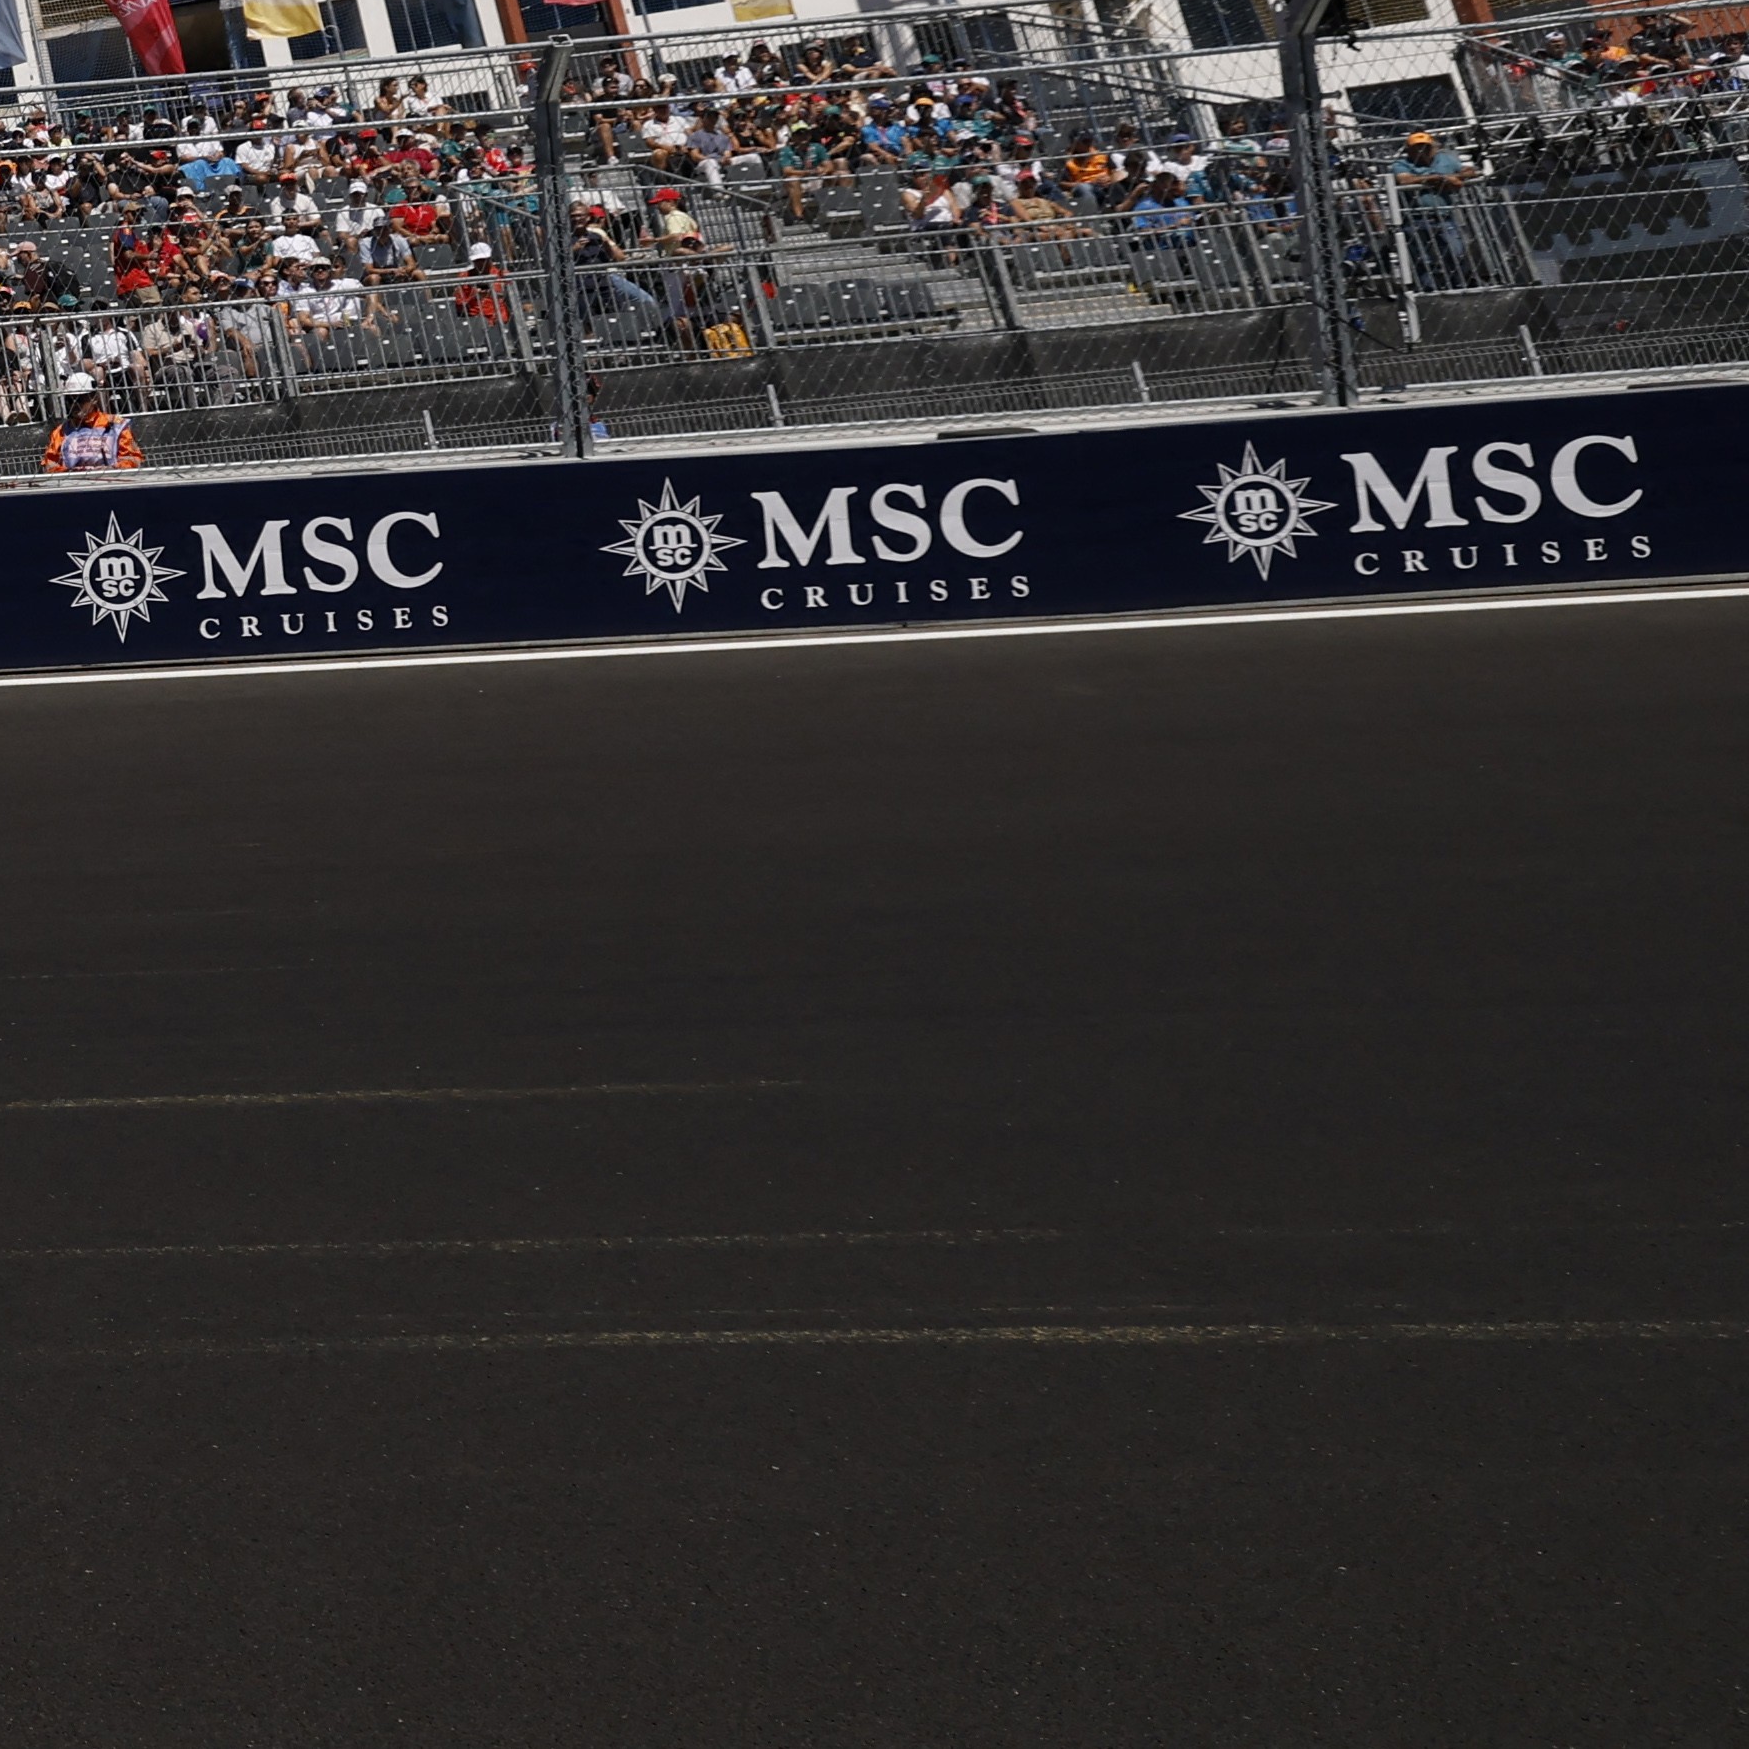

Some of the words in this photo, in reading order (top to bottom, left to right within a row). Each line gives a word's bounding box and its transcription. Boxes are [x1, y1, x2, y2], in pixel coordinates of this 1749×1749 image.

[1340, 435, 1643, 532] MSC
[751, 479, 1024, 568] MSC
[191, 512, 444, 599] MSC
[1355, 536, 1651, 575] CRUISES
[200, 606, 449, 639] CRUISES
[761, 576, 1030, 610] CRUISES
